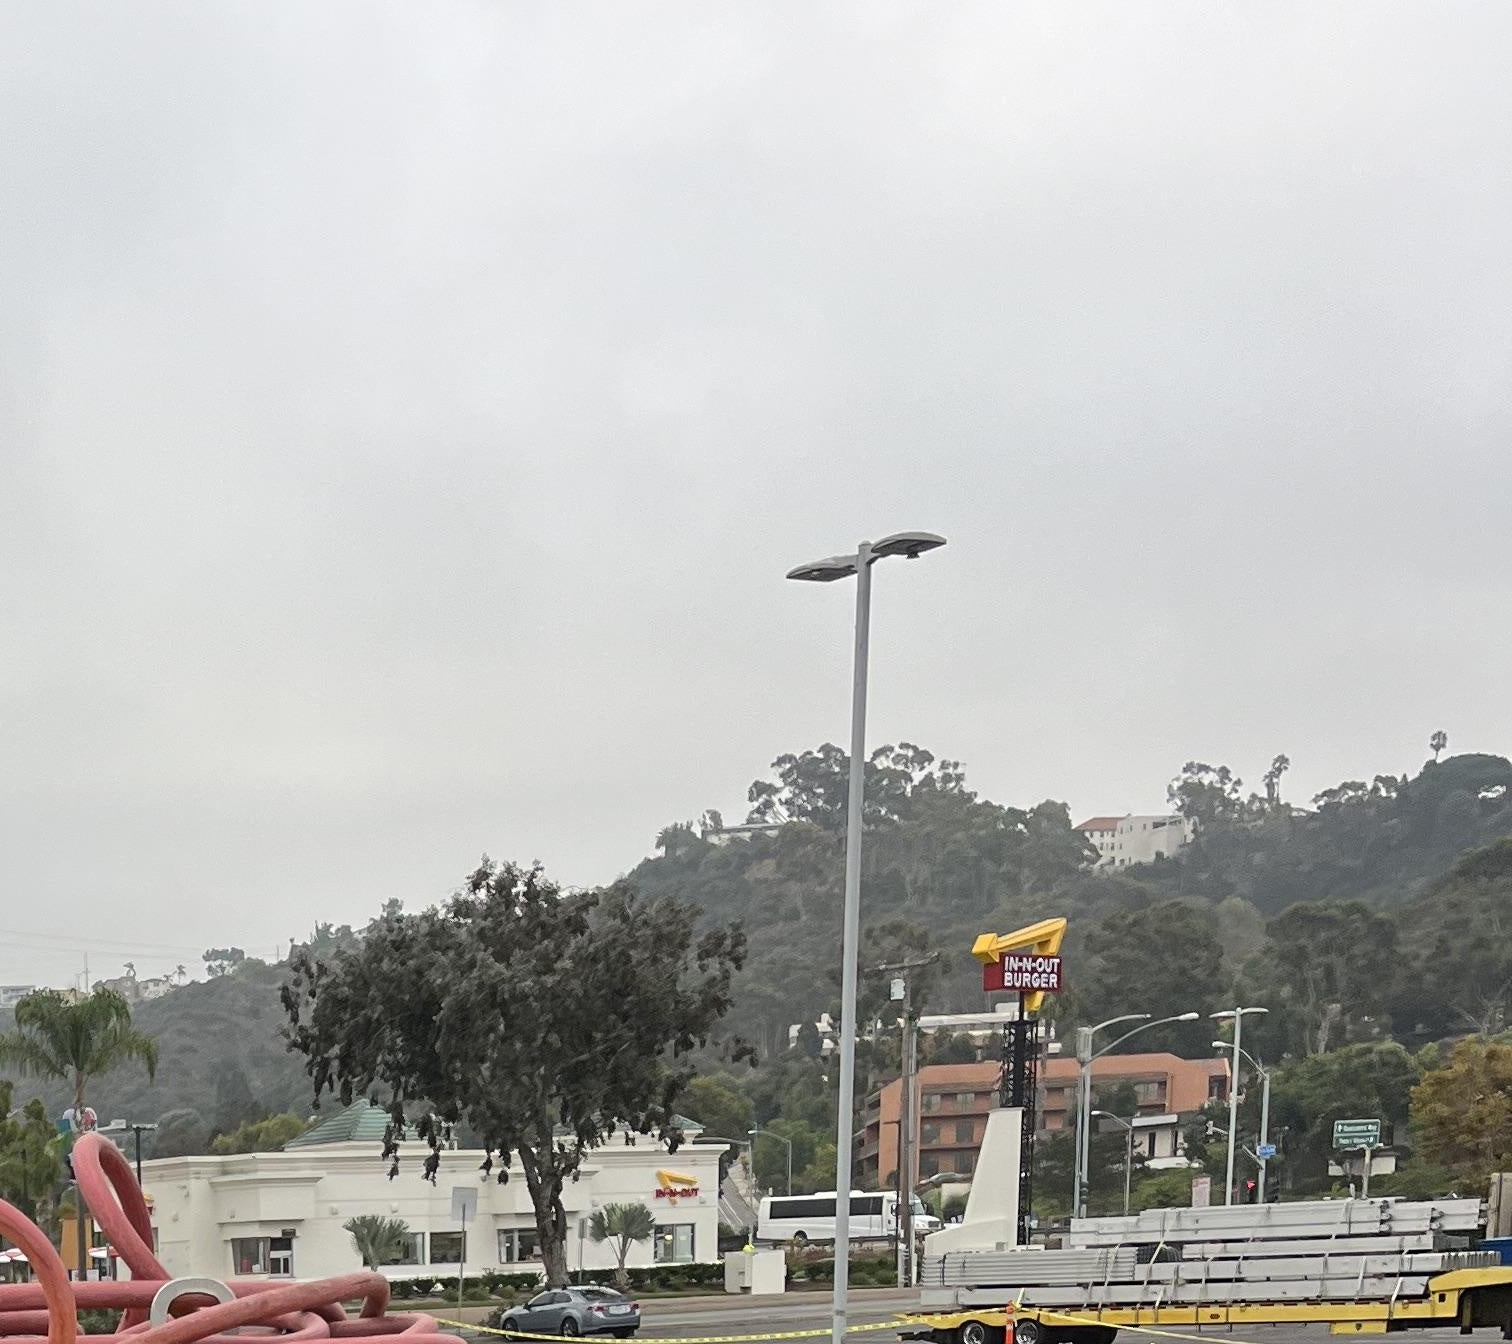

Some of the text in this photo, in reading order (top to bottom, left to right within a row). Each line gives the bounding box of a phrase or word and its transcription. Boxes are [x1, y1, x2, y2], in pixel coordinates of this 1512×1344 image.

[1004, 956, 1061, 973] IN-N-OUT
[1004, 971, 1058, 988] BURGER
[655, 1188, 699, 1198] IN-N-OUT
